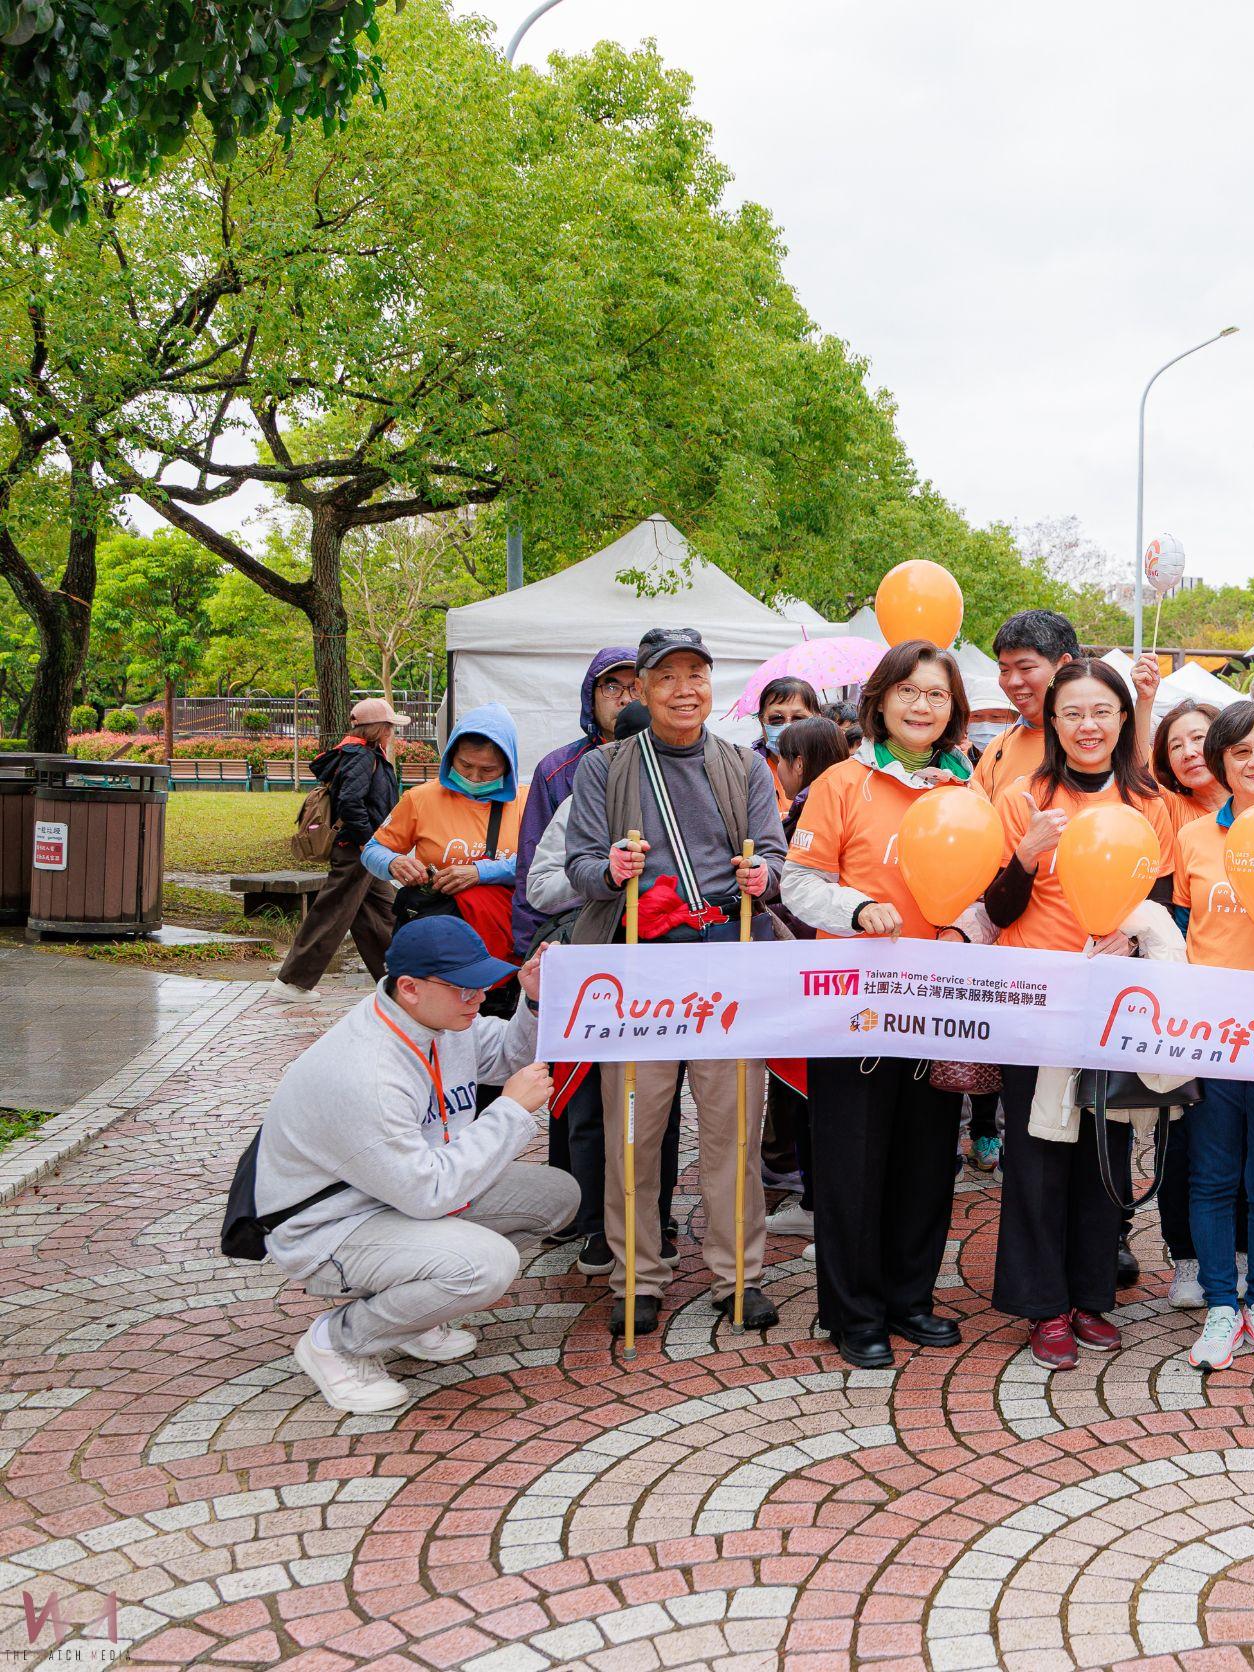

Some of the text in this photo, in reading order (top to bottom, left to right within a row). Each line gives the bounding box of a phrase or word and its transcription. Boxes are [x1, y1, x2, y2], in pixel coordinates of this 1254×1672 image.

[866, 970, 1047, 991] Taiwan Home Service Strategic Alliance
[864, 981, 1047, 1006] 社團法人台灣居家服務策略聯盟
[584, 1022, 688, 1039] Taiwan
[884, 1013, 990, 1040] RUN TOMO
[1121, 1035, 1222, 1062] Taiwan
